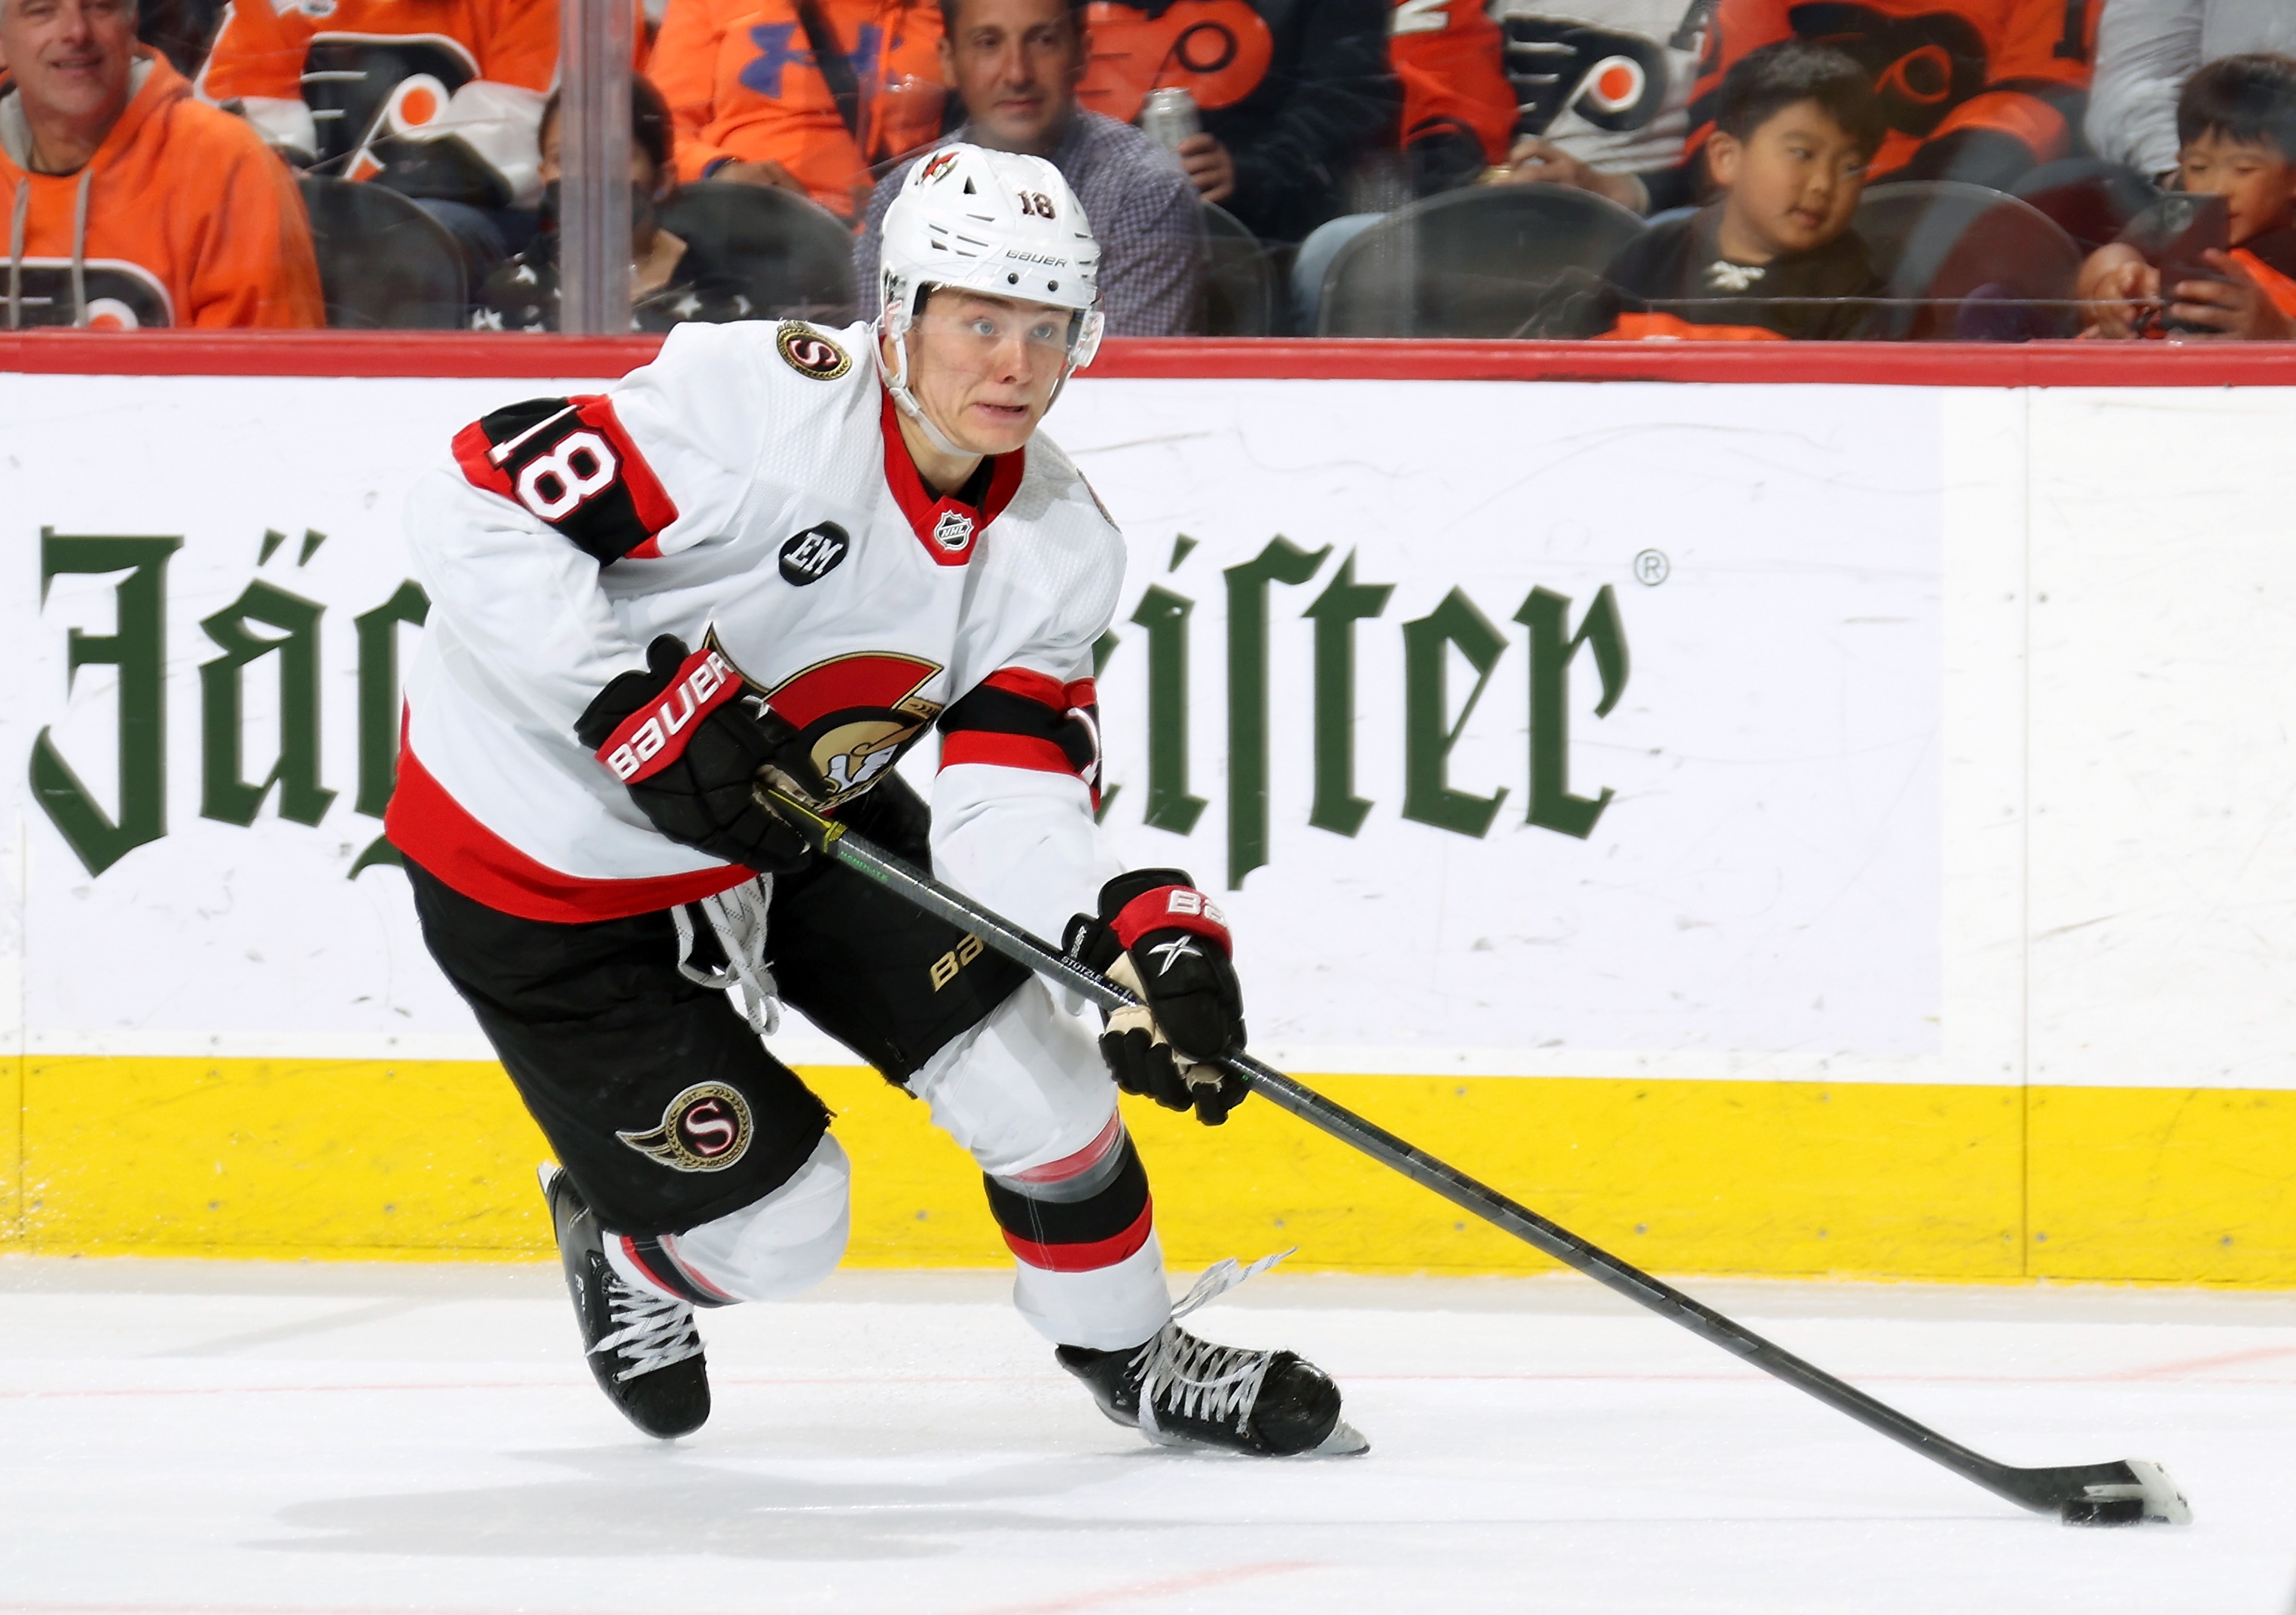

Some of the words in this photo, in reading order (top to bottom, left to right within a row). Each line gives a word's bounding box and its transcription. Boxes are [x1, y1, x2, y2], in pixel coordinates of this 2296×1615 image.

[1018, 190, 1056, 219] 18
[1006, 249, 1067, 267] BAUER
[485, 403, 624, 523] 18
[941, 525, 964, 538] NHL
[783, 532, 844, 575] EM
[607, 651, 735, 781] BAUER
